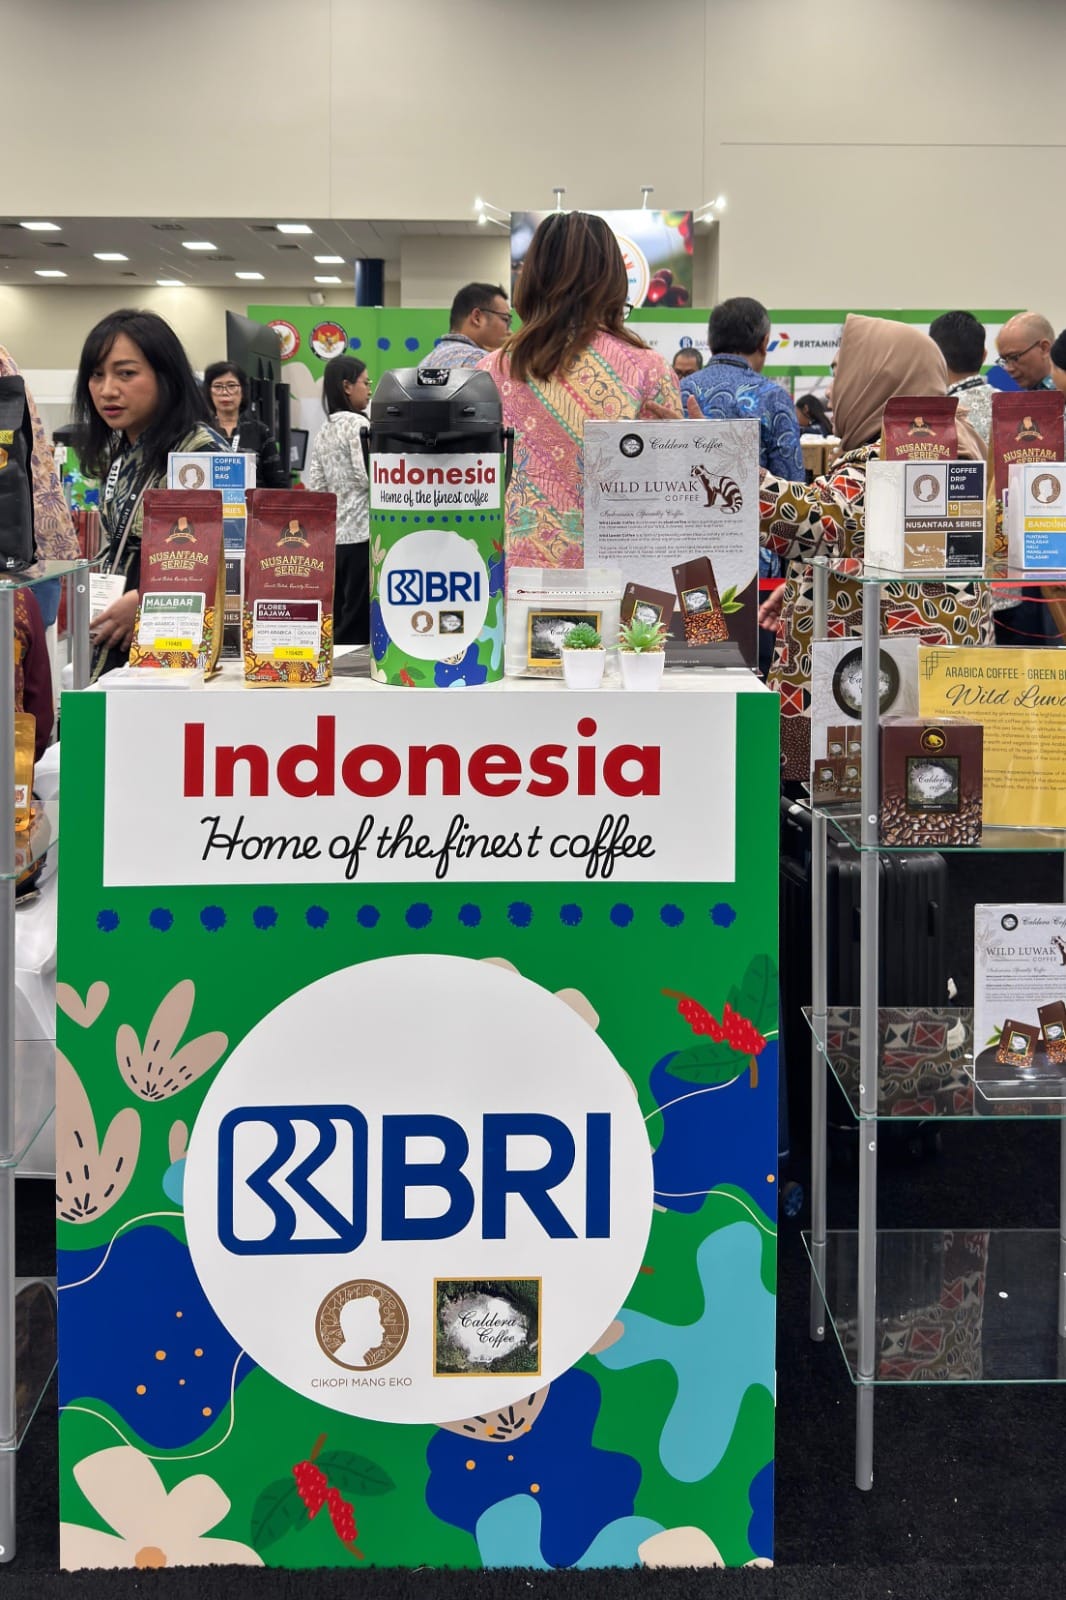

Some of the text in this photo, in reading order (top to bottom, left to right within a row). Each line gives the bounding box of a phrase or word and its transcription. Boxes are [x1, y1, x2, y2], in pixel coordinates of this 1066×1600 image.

[649, 436, 724, 453] Caldera Coffee
[895, 442, 951, 457] NUSANTARA
[908, 451, 940, 460] SERIES
[1003, 448, 1057, 463] NUSANTARA
[373, 459, 496, 485] Indonesia
[599, 480, 698, 493] WILD LUWAK
[380, 489, 489, 507] Home of the finest coffee
[665, 494, 701, 502] COFFEE
[905, 520, 982, 529] NUSANTARA SERIES
[149, 551, 209, 565] NUSANTARA
[161, 559, 196, 571] SERIES
[260, 555, 325, 572] NUSANTARA
[274, 565, 311, 577] SERIES
[426, 571, 481, 602] BRI
[146, 598, 193, 606] MALABAR
[945, 667, 984, 678] ARABICA
[986, 667, 1019, 679] COFFEE
[1027, 669, 1057, 680] GREEN
[945, 684, 1010, 706] Wild
[183, 715, 660, 797] Indonesia
[200, 814, 656, 880] Home of the finest coffee
[986, 947, 1056, 956] WILD LUWAK
[381, 1112, 612, 1241] BRI
[457, 1310, 517, 1328] Caldera
[476, 1327, 515, 1348] Coffee
[311, 1377, 413, 1388] CIKOPI MANG EKO
